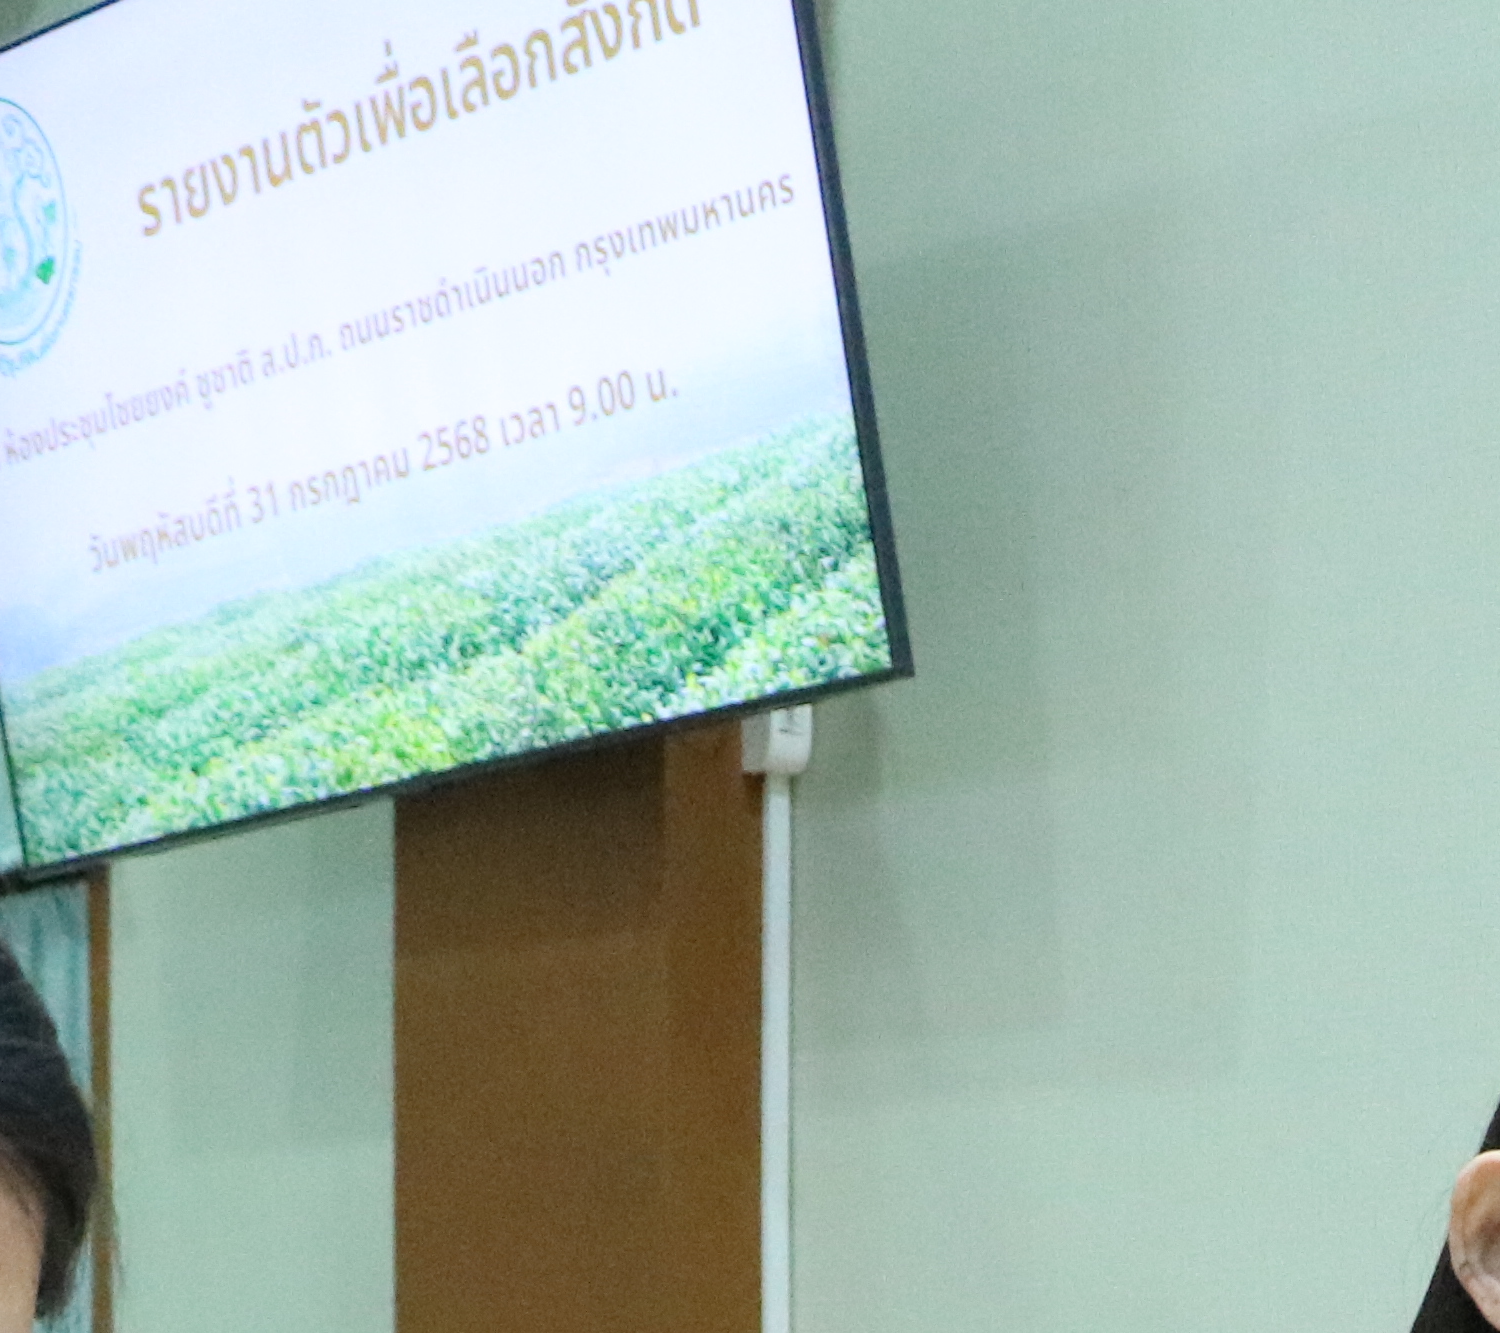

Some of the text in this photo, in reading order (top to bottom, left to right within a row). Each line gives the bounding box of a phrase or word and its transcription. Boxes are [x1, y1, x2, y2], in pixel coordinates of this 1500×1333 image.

[137, 0, 701, 237] รายงานตัวเพื่อเลือกสังกด
[196, 349, 255, 410] ชูชาติ
[261, 332, 332, 378] ส.ป.ก.
[339, 250, 567, 352] ถนนราชดำเนินนอก
[575, 173, 795, 276] กรุงเทพมหานคร
[89, 368, 678, 573] วันพฤหัสบดีที่ 31 กรกฎาคม 2568 เวลา 9.00 น.
